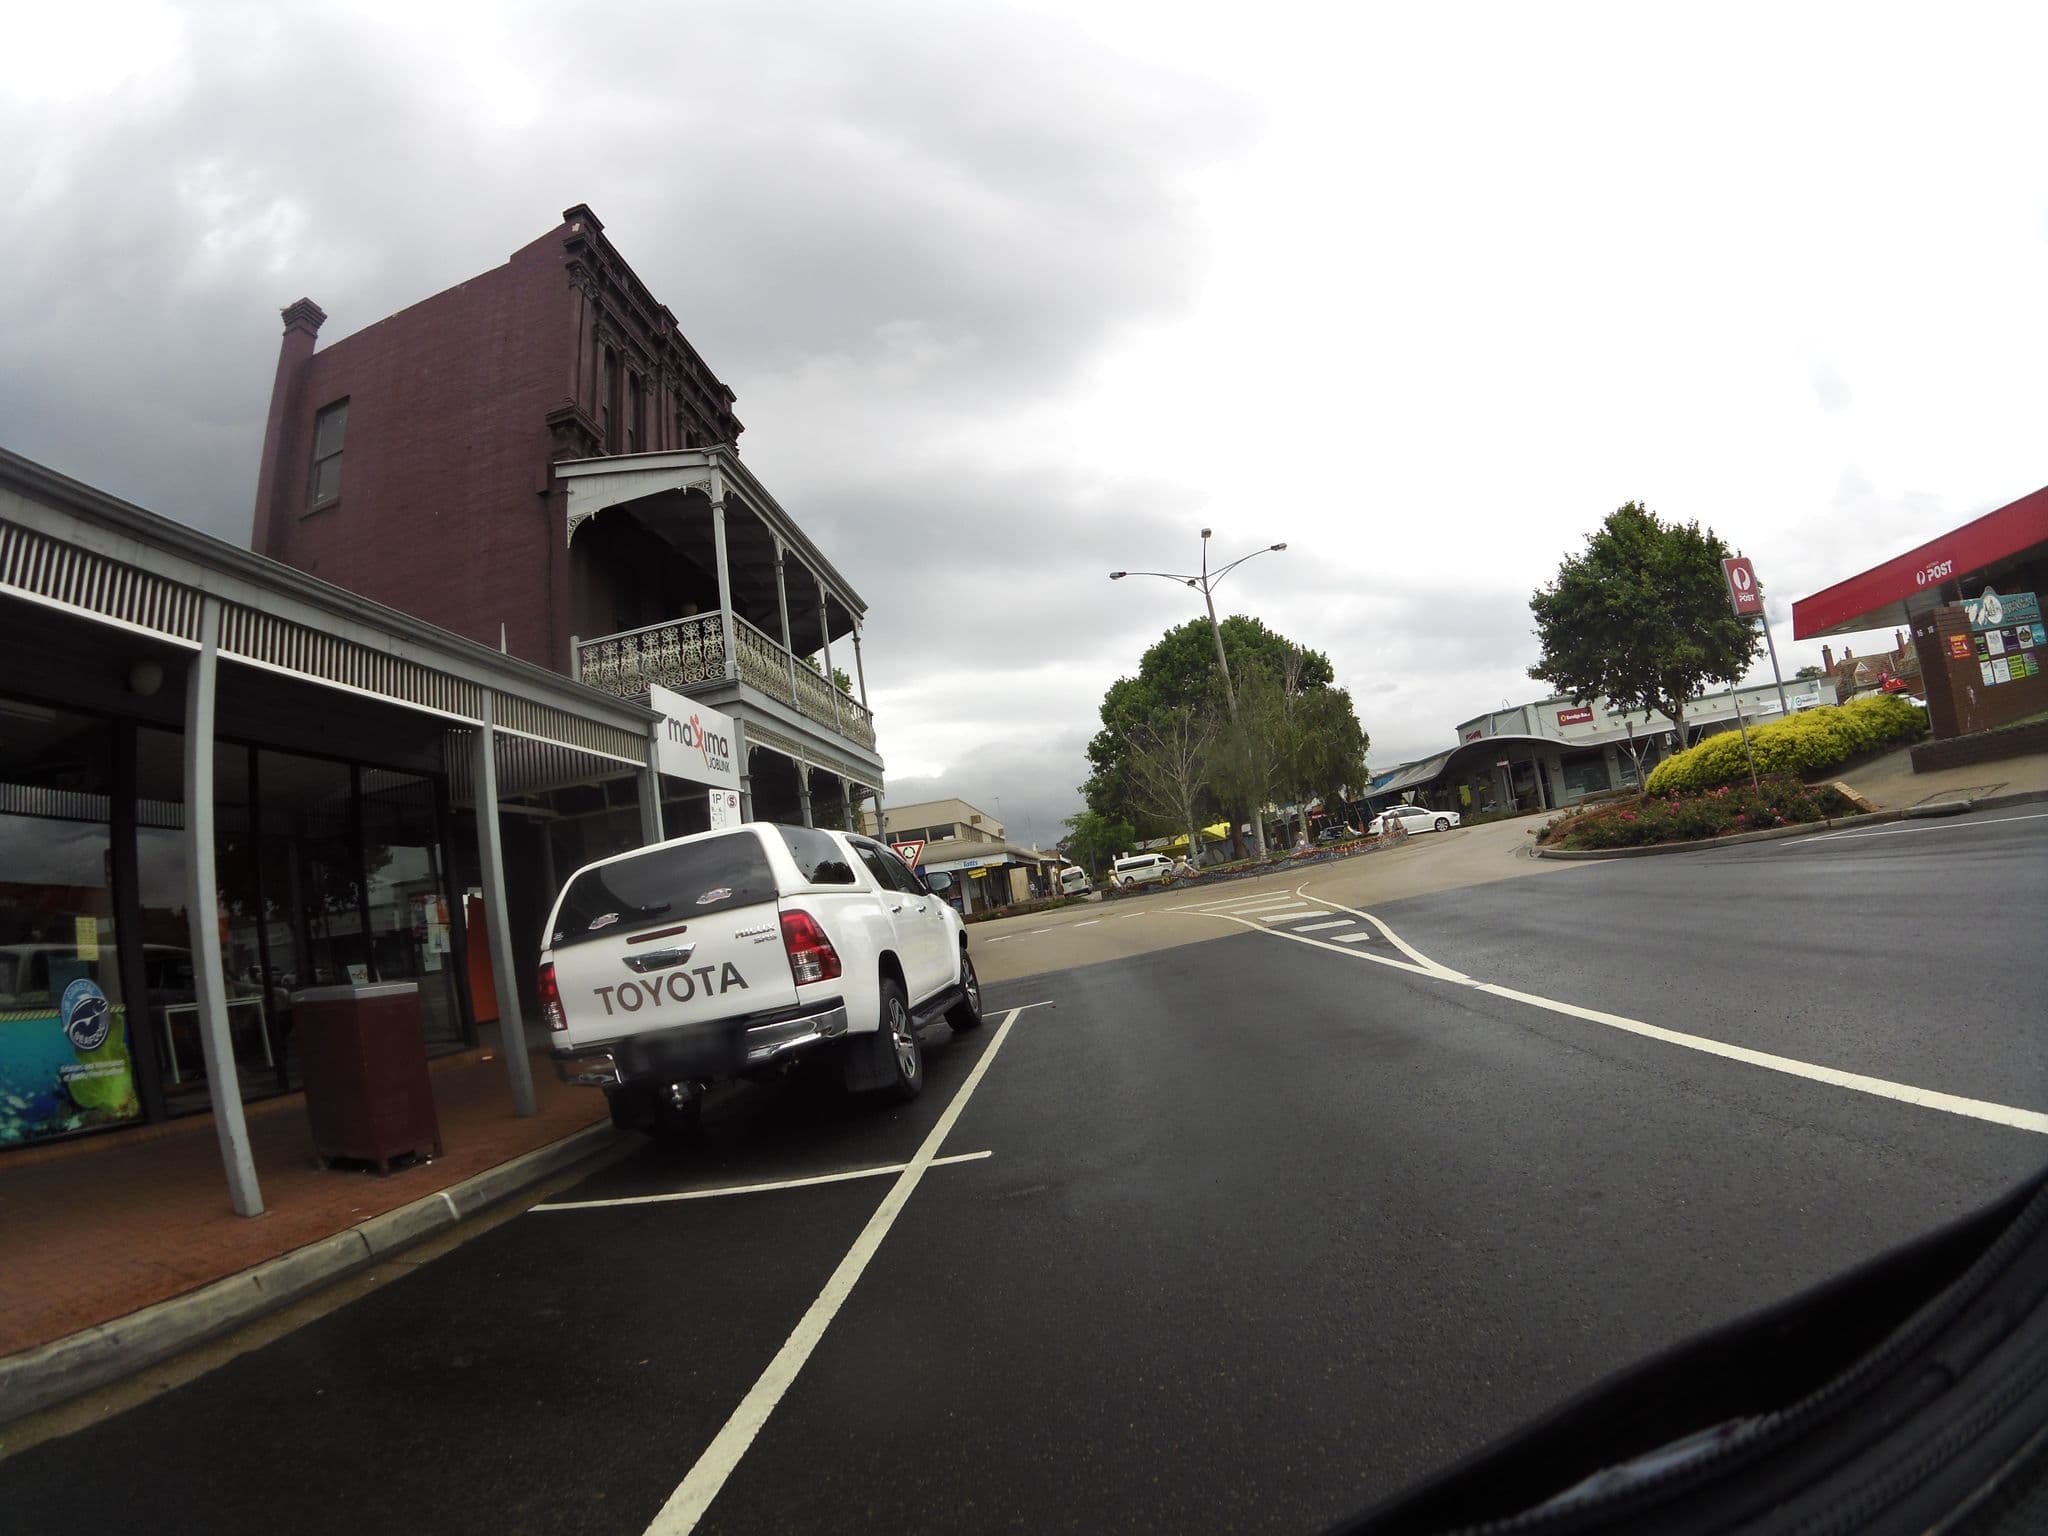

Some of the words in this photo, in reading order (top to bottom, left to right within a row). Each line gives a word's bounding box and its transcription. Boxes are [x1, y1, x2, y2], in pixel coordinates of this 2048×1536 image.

[1927, 560, 1952, 581] POST
[668, 714, 729, 761] maxima
[712, 793, 722, 805] 1P
[594, 961, 750, 1015] TOYOTA
